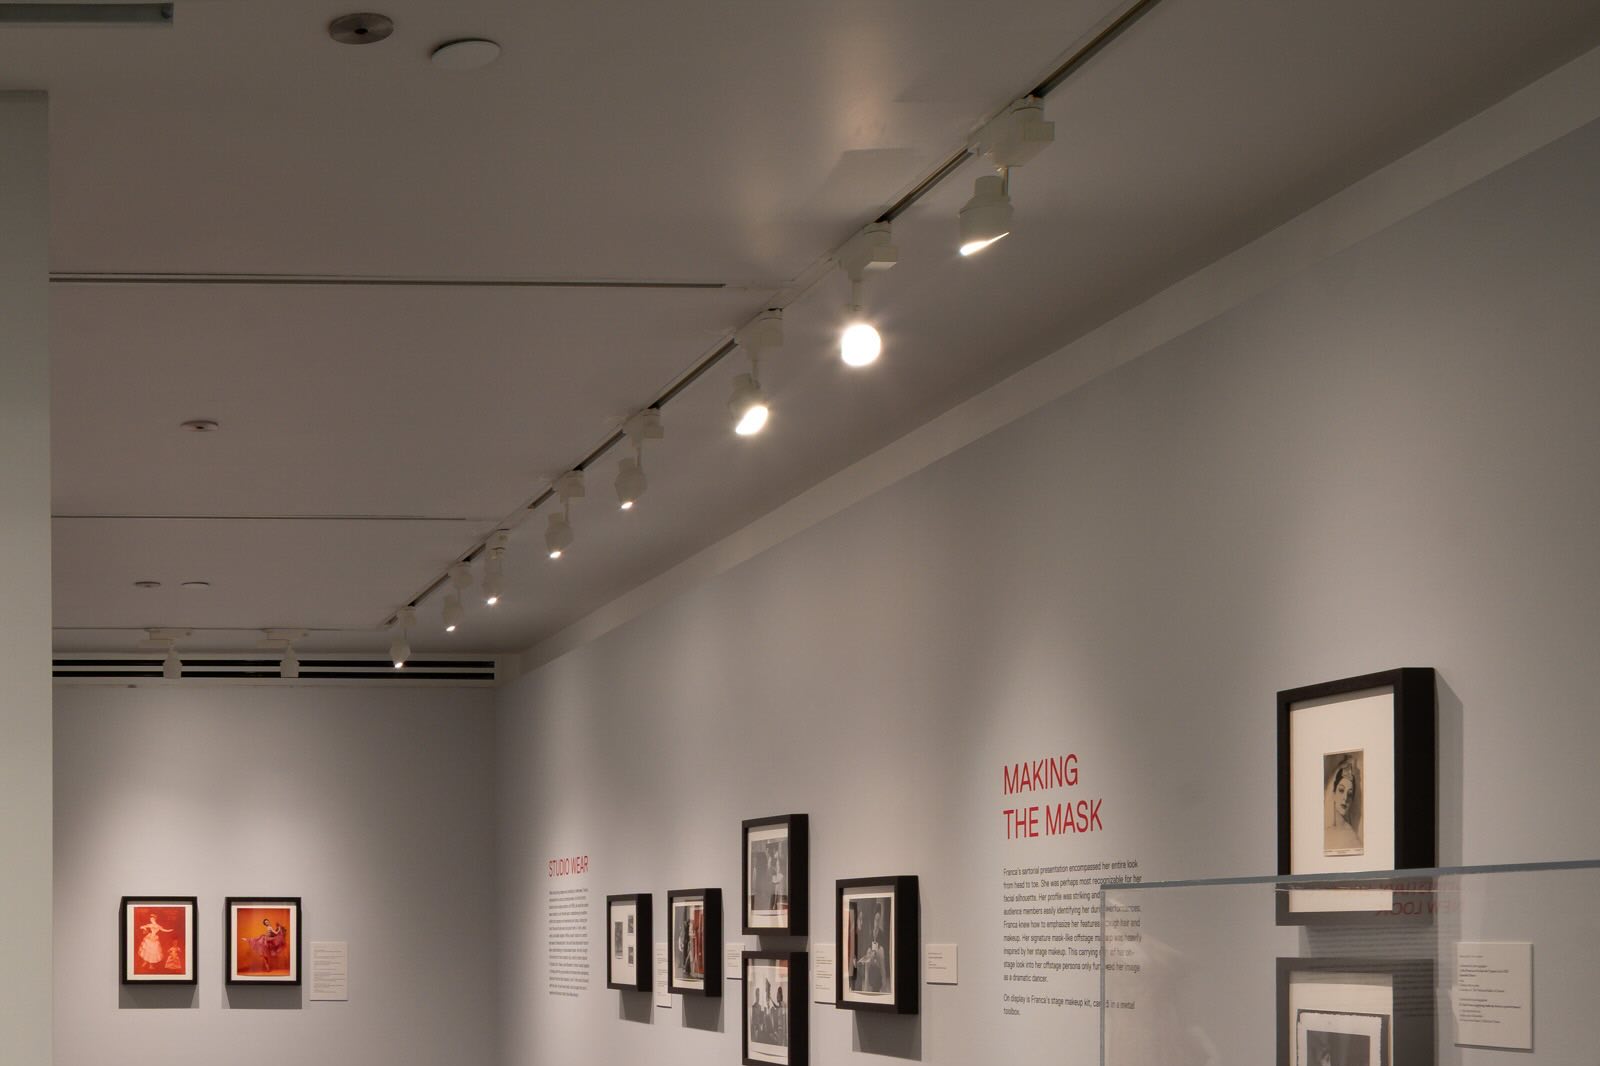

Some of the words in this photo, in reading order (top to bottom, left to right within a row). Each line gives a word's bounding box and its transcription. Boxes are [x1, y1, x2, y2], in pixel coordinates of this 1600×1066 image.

[1003, 753, 1079, 796] MAKING
[1003, 806, 1039, 839] THE
[1045, 798, 1103, 836] MASK
[548, 858, 570, 877] STUDIO
[571, 855, 589, 874] WEAR
